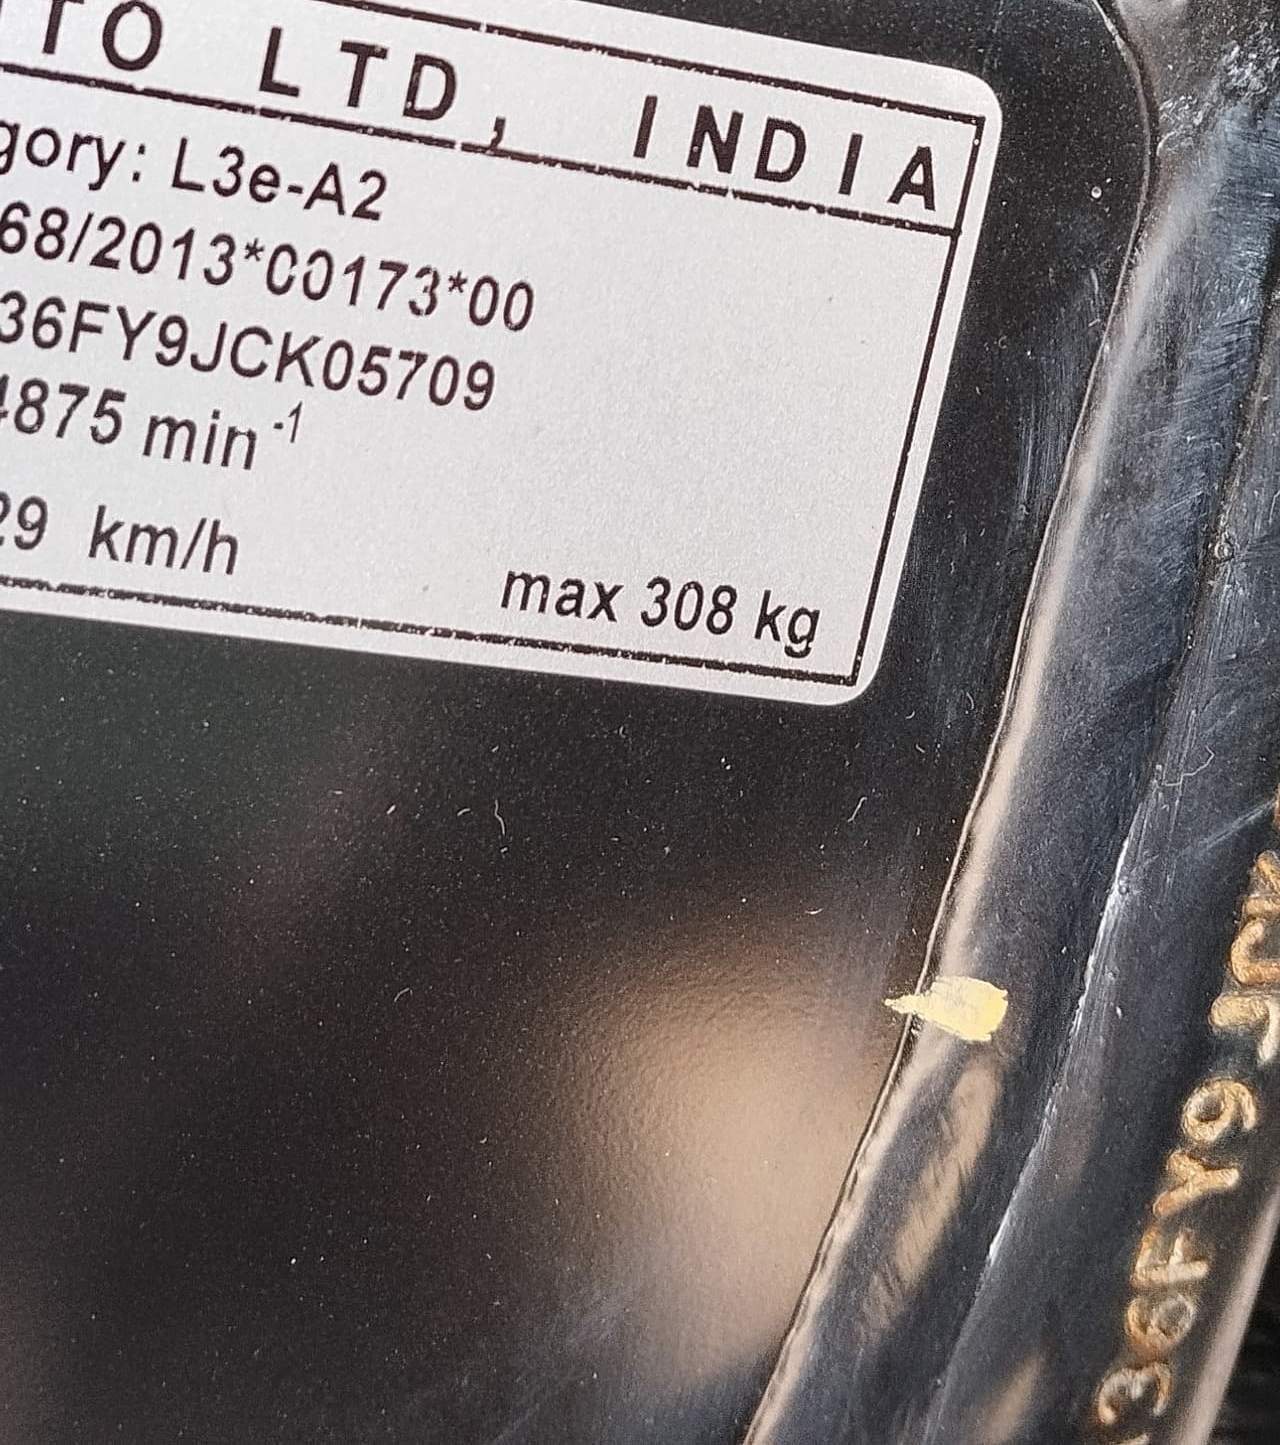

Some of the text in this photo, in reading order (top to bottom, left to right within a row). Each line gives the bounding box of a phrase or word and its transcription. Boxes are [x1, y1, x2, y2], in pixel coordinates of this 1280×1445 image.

[258, 25, 508, 152] LTD,
[632, 94, 938, 212] INDIA
[170, 136, 388, 222] L3e-A2
[87, 504, 239, 576] km/h
[500, 570, 821, 659] max 308 kg
